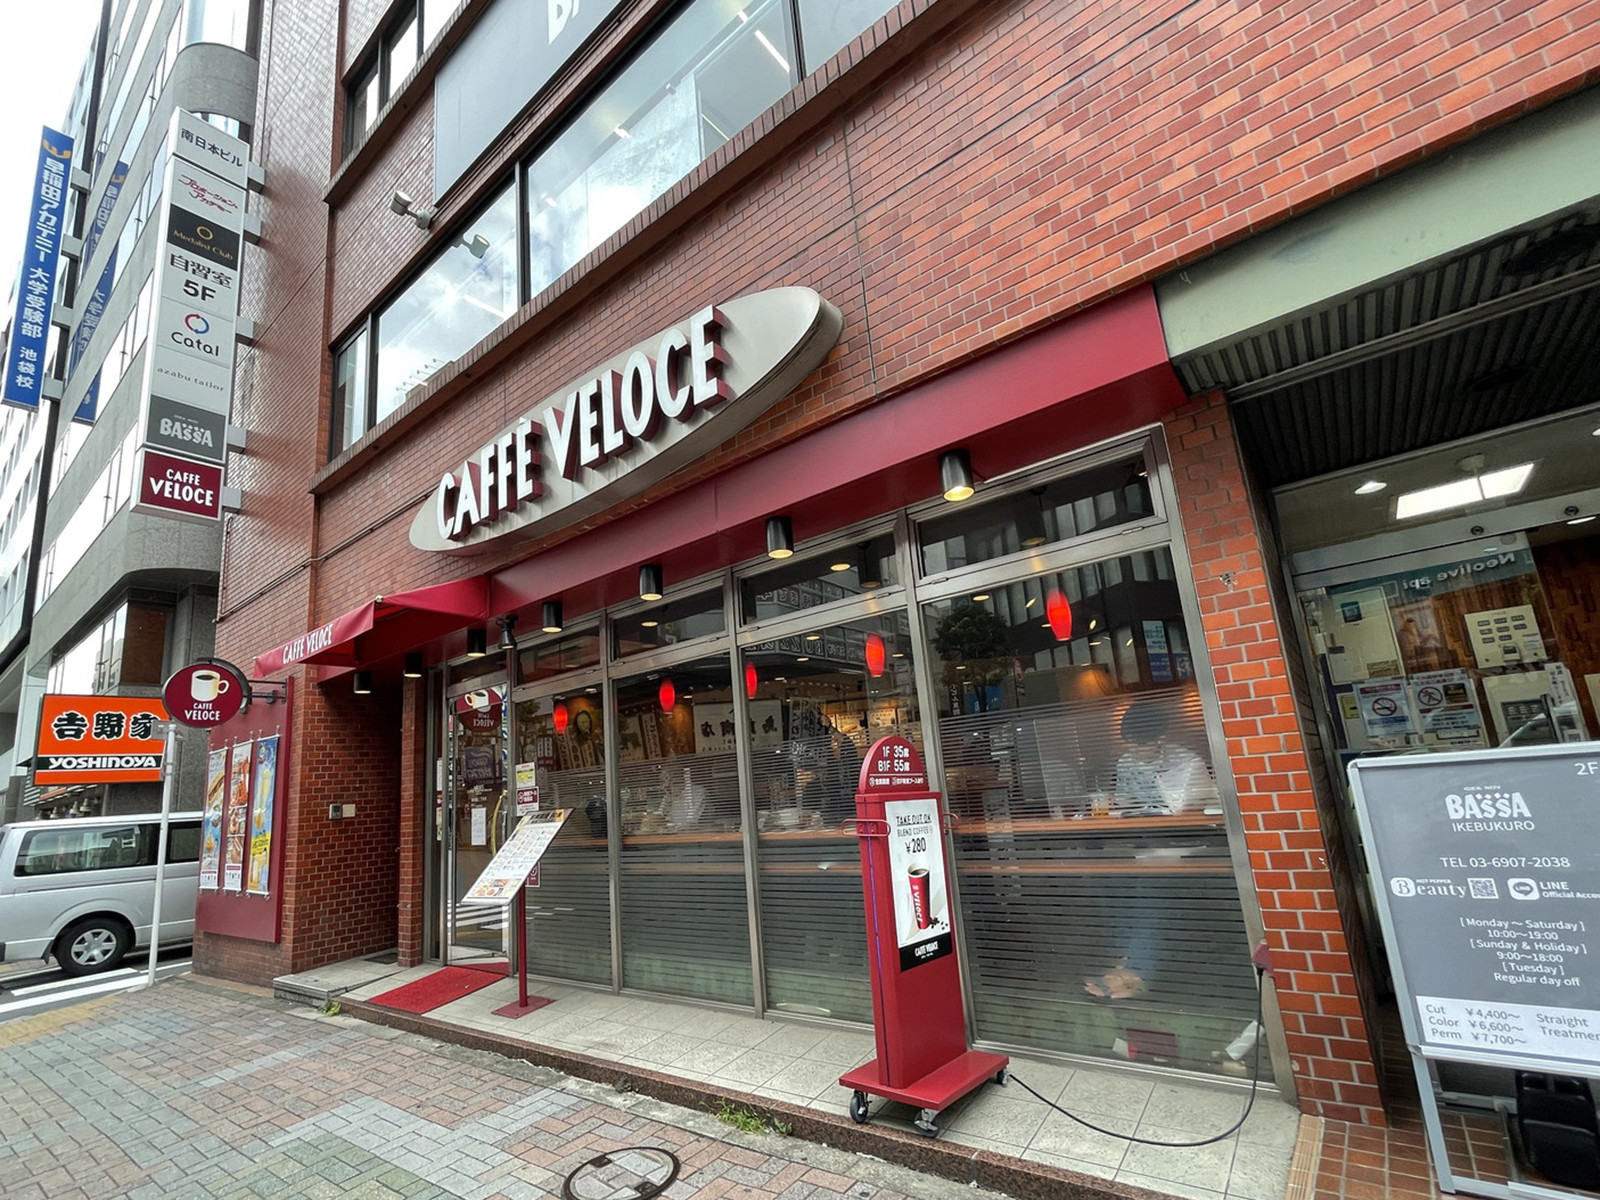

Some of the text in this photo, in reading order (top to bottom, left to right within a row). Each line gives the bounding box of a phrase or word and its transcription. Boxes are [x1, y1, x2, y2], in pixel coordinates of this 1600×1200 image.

[181, 127, 243, 167] 南日本ビル
[173, 229, 233, 261] Medalist Club
[16, 157, 64, 390] 早稲田アカデミー 大学受験部 池袋校
[170, 253, 232, 289] 自習室
[183, 279, 216, 301] 5F
[171, 331, 219, 356] Catal
[157, 367, 224, 391] azabu tailor
[543, 304, 728, 482] VELOCE
[166, 468, 200, 486] CAFFE
[149, 476, 214, 507] VELOCE
[306, 623, 333, 655] VELOCE
[184, 710, 220, 721] VELOCE
[882, 745, 890, 758] 1F
[49, 756, 157, 770] YOSHINOYA
[1574, 761, 1599, 776] 2F
[896, 815, 911, 825] TAKE
[912, 814, 922, 825] OUT
[1452, 820, 1535, 832] IKEBUKURO
[897, 828, 912, 837] BLEND
[905, 837, 927, 854] ¥280
[1440, 857, 1571, 868] TEL 03-6907-2038
[1539, 881, 1569, 890] LINE
[1542, 891, 1574, 899] Official
[1521, 941, 1531, 950] &
[1493, 972, 1580, 987] Regular day off
[1426, 1003, 1446, 1016] Cut
[1536, 1013, 1589, 1029] Straight
[1428, 1016, 1460, 1028] Color
[1431, 1027, 1463, 1041] Perm
